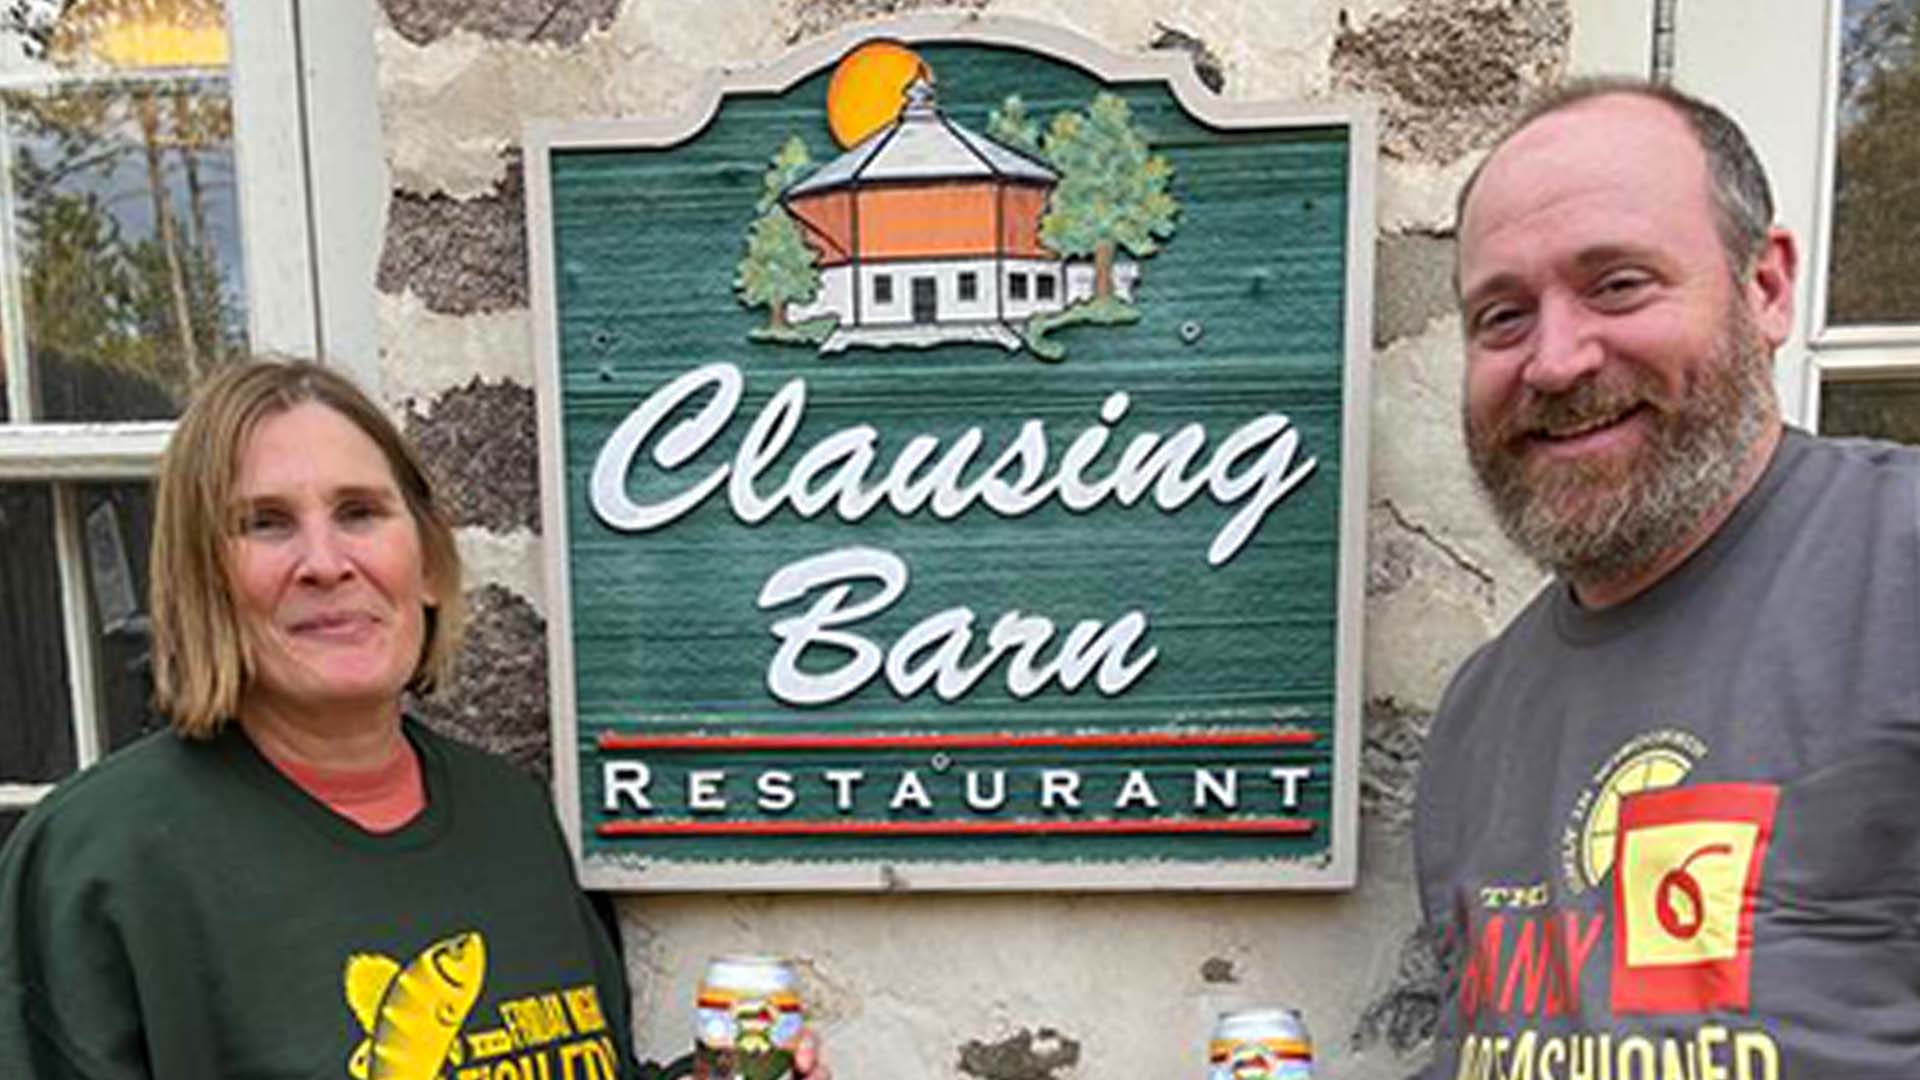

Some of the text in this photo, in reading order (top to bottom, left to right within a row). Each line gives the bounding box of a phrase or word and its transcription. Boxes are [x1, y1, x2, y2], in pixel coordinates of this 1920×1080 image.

[589, 362, 1316, 565] Clausing
[756, 547, 1158, 703] Barn
[603, 760, 1311, 812] RESTAURANT
